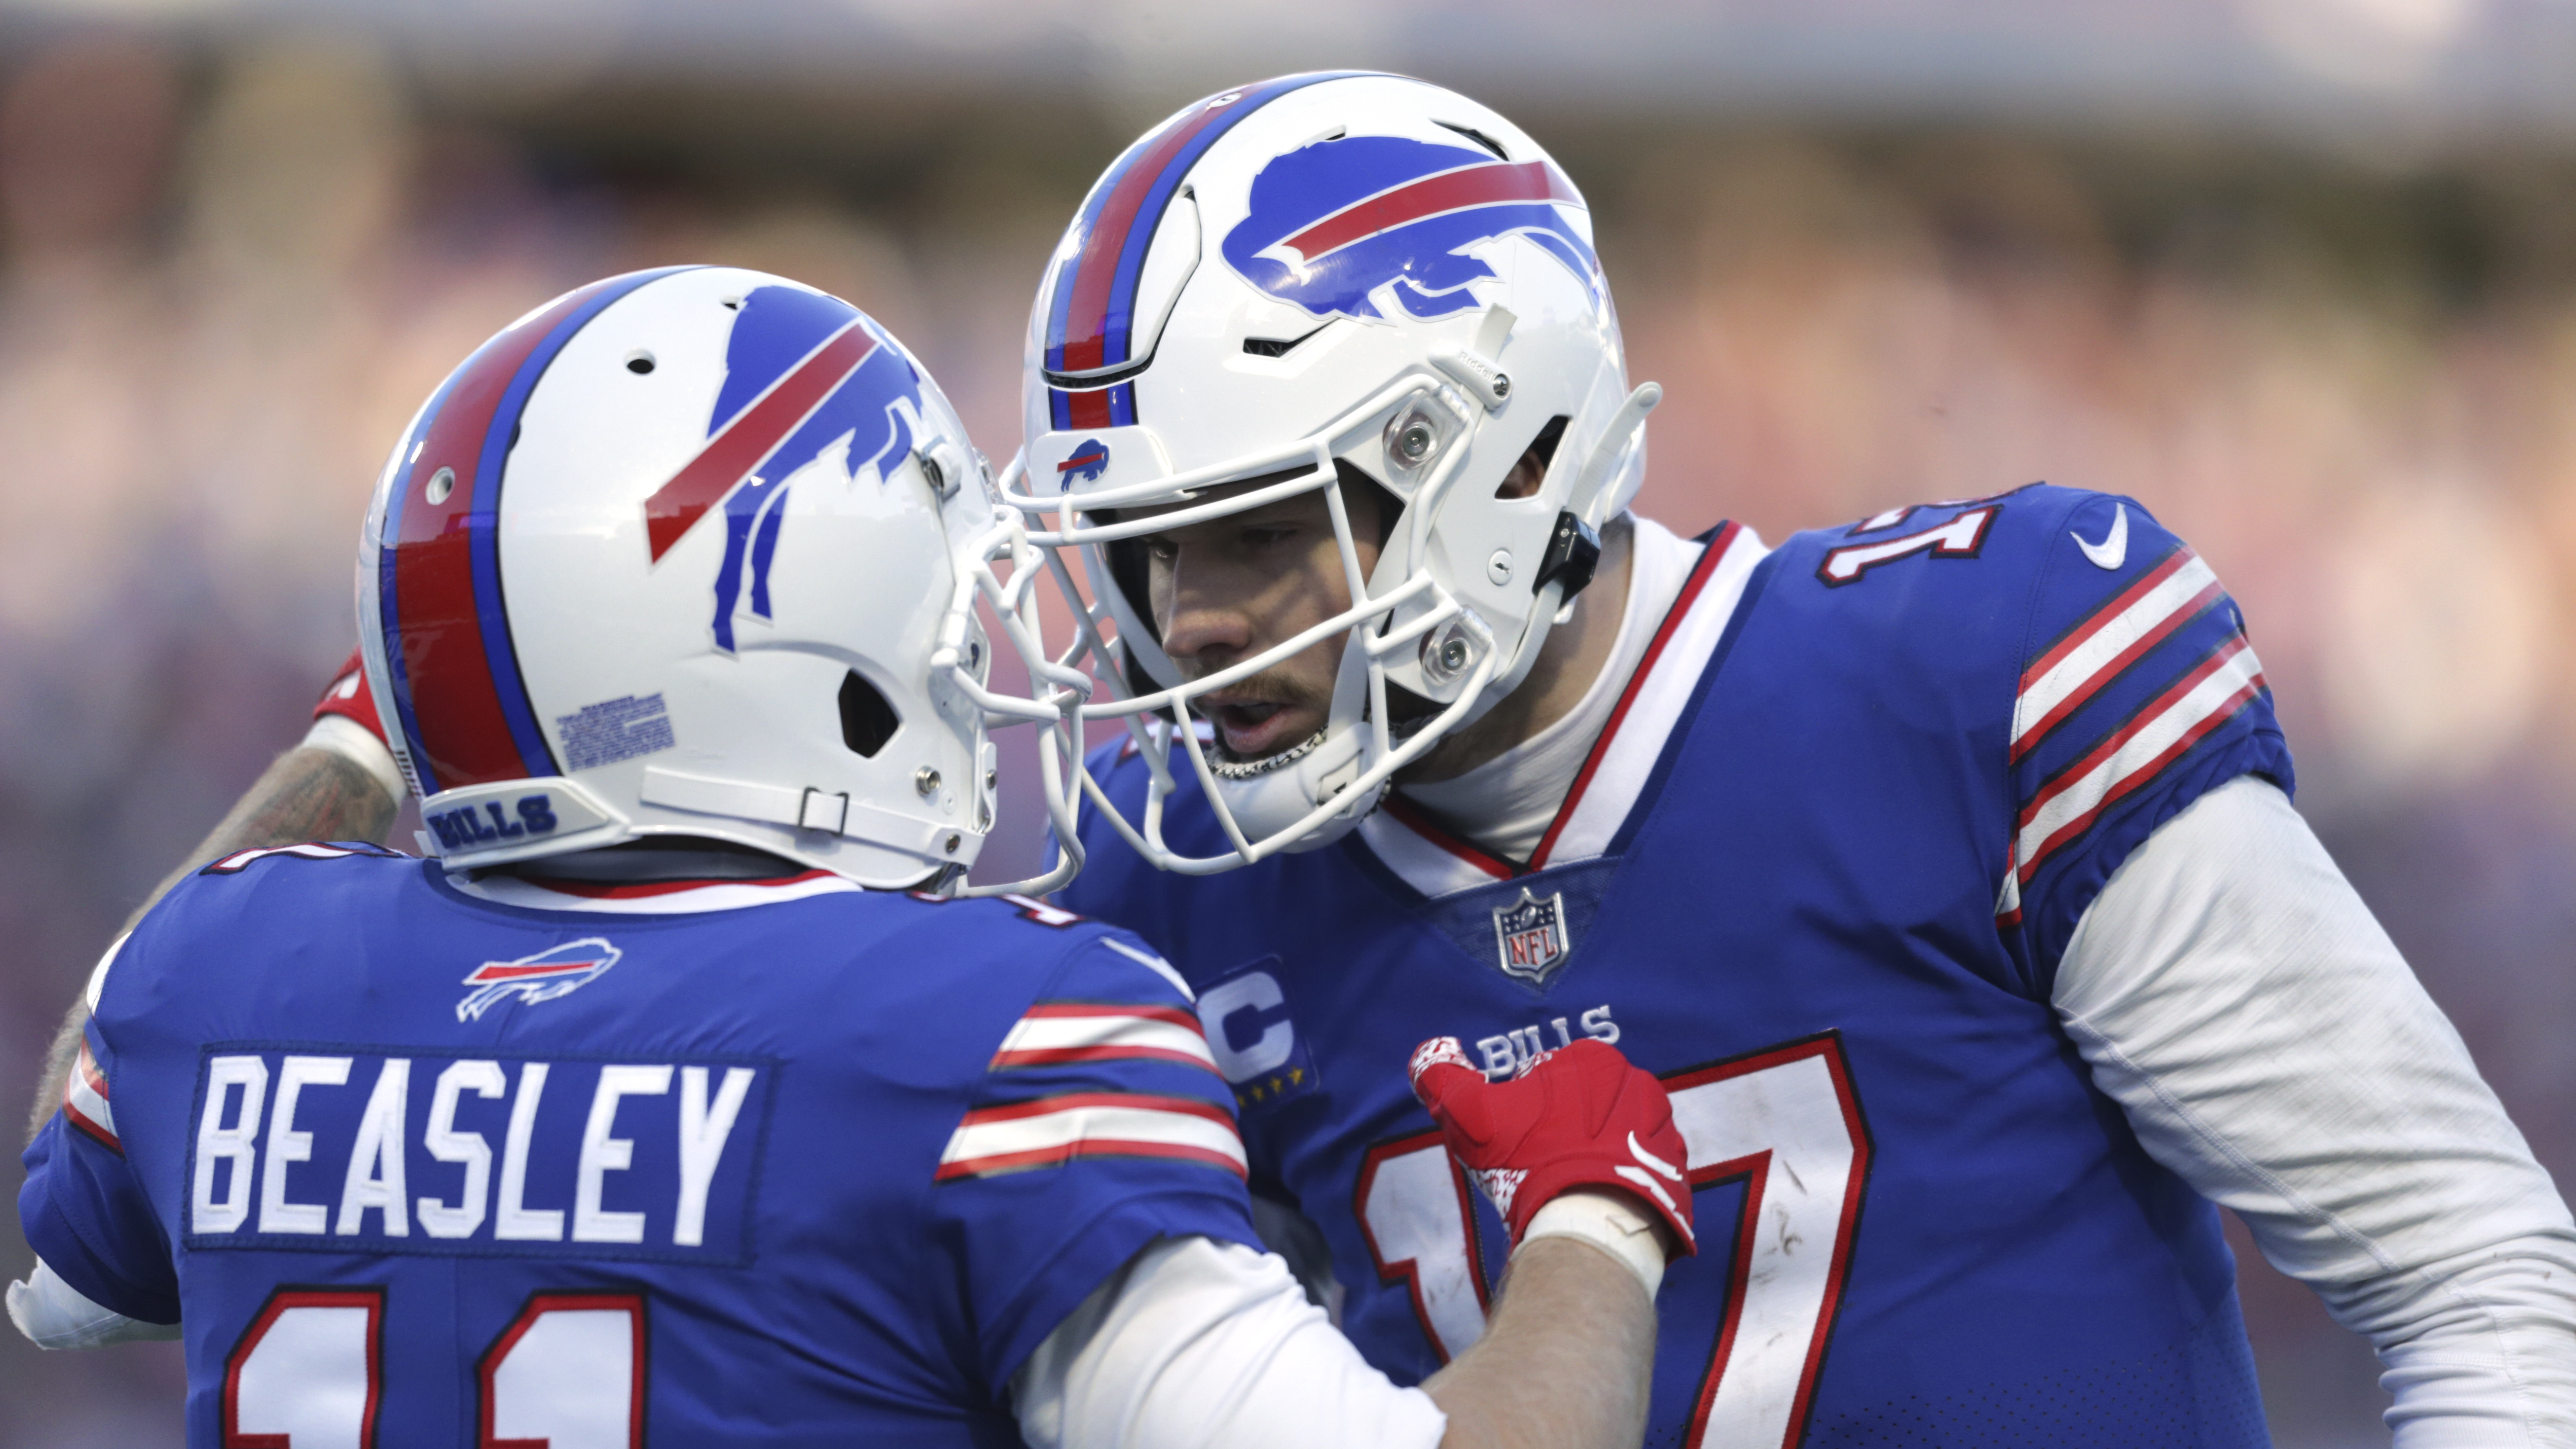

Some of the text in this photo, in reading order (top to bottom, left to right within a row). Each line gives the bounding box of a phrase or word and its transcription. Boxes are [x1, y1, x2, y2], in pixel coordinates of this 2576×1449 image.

[427, 793, 558, 849] BILLS
[1509, 927, 1558, 965] NFL
[1196, 971, 1294, 1085] C
[192, 1055, 756, 1247] BEASLEY
